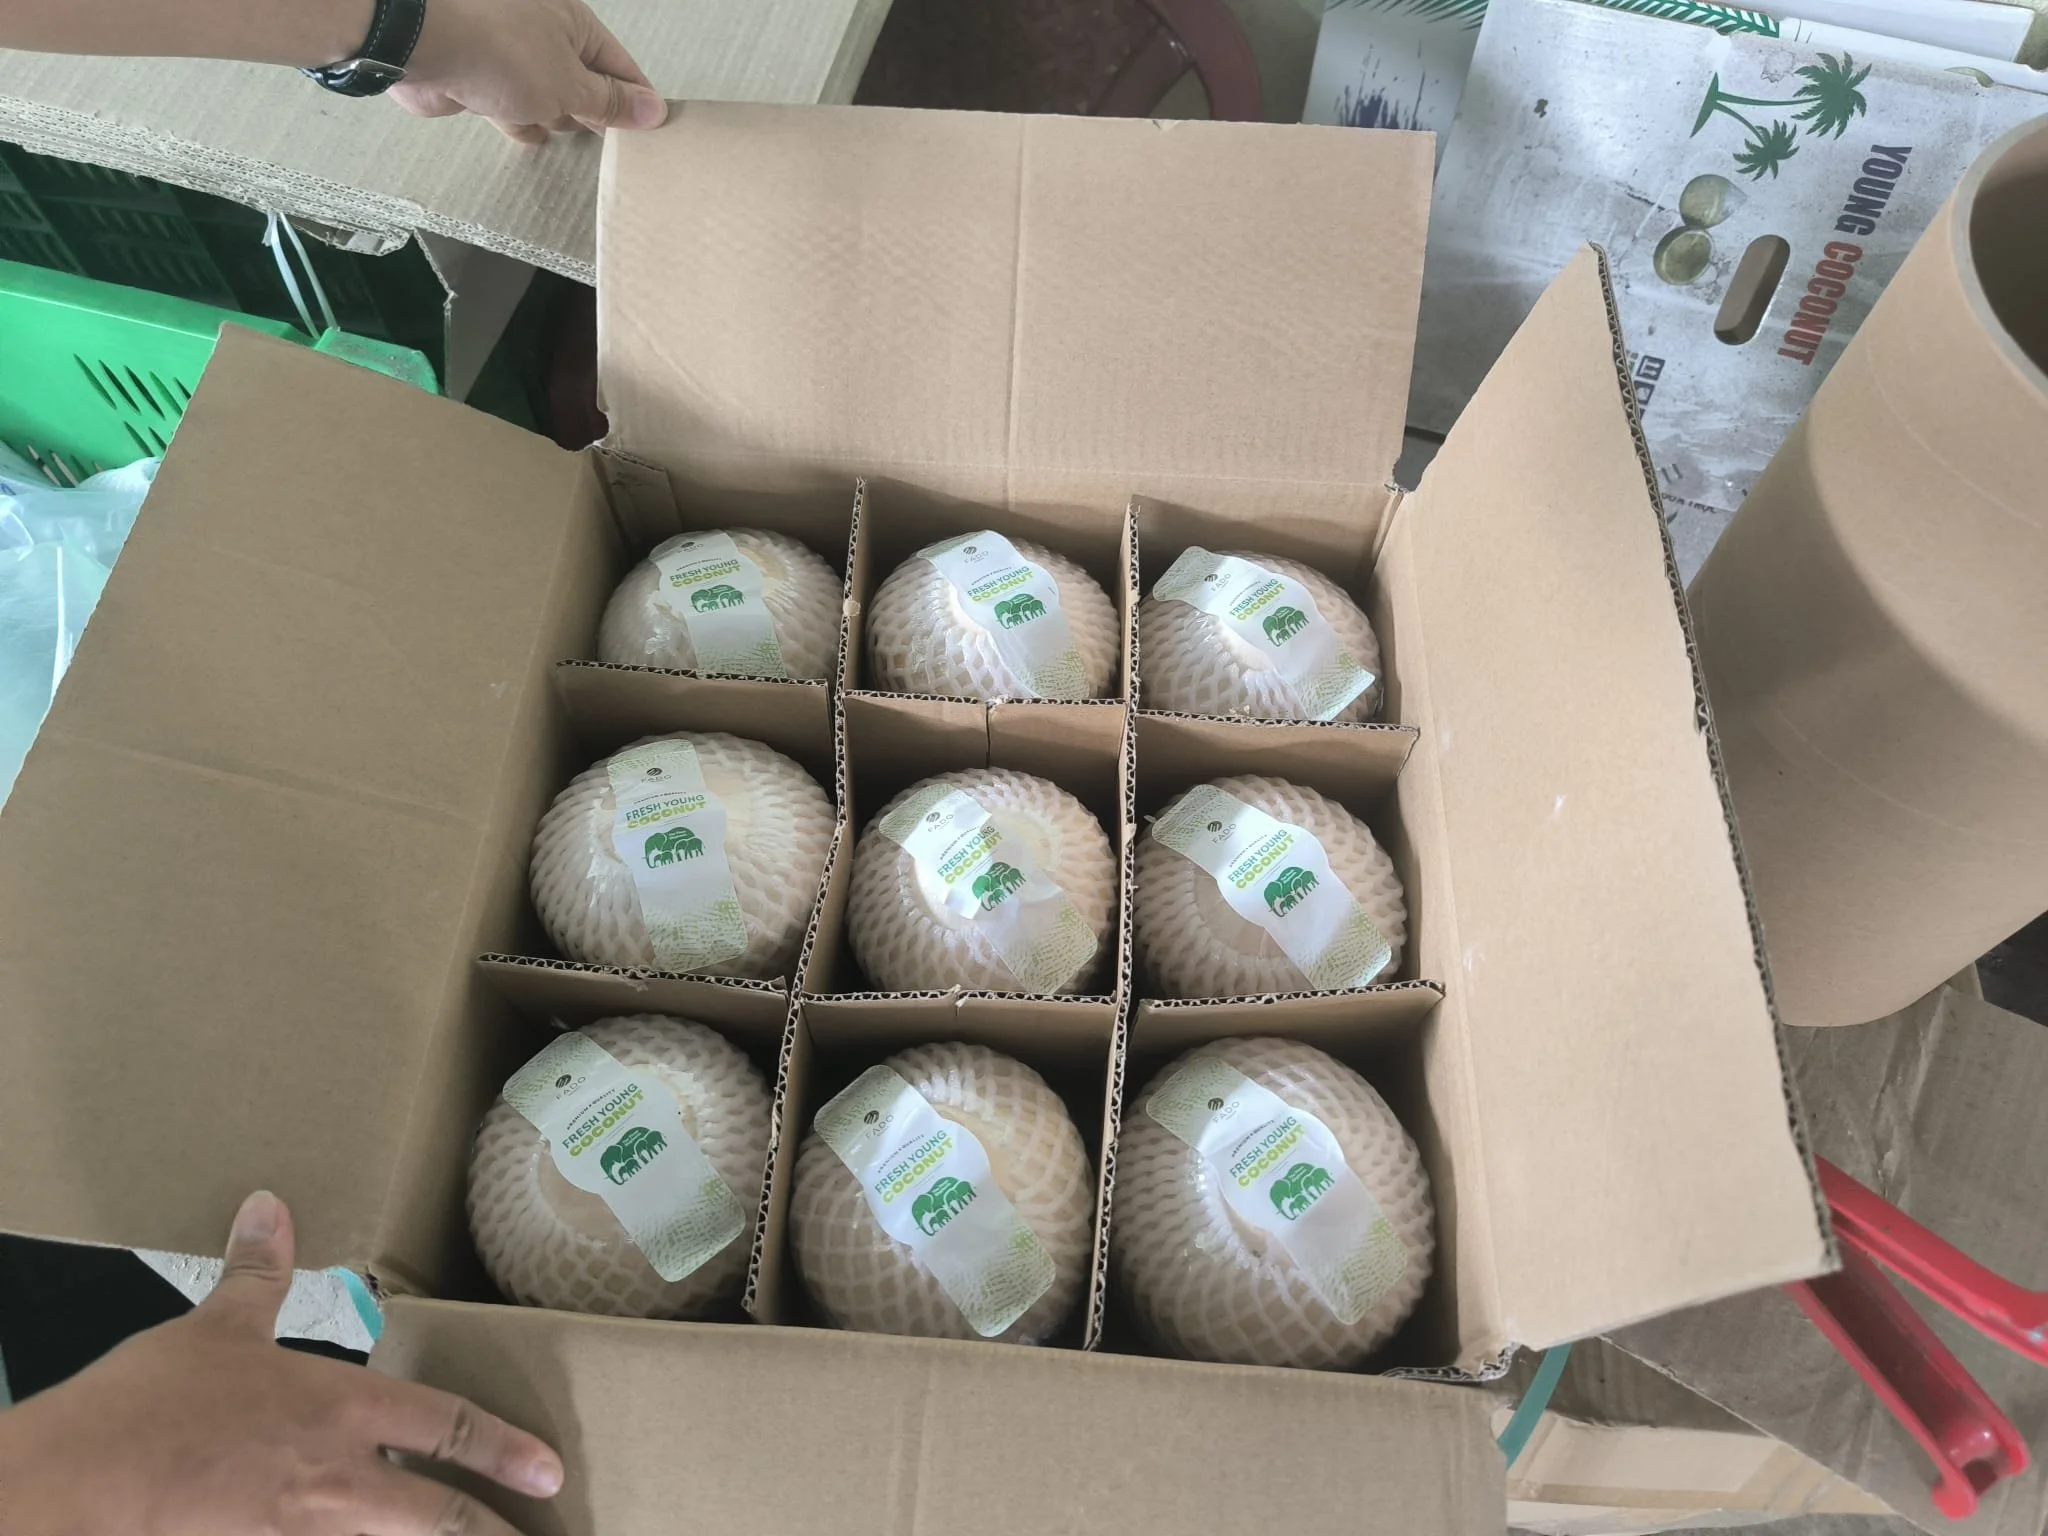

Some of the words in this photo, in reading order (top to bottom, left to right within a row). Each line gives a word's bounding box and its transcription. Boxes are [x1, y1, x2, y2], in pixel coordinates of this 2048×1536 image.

[1834, 144, 1913, 236] YOUNG
[1777, 240, 1863, 366] COCONUT
[670, 569, 701, 581] FRESH
[703, 559, 737, 572] YOUNG
[673, 566, 741, 587] COCONUT
[968, 580, 997, 596] FRESH
[998, 566, 1029, 582] YOUNG
[972, 572, 1033, 601] COCONUT
[1230, 595, 1255, 616] FRESH
[1254, 579, 1278, 598] YOUNG
[1237, 584, 1285, 620] COCONUT
[625, 802, 661, 821] FRESH
[663, 795, 704, 806] YOUNG
[627, 801, 706, 828] COCONUT
[937, 848, 969, 876] FRESH
[965, 826, 995, 849] YOUNG
[945, 831, 1002, 884] COCONUT
[1228, 855, 1258, 882] FRESH
[1254, 829, 1287, 856] YOUNG
[1236, 834, 1294, 888] COCONUT
[562, 1115, 600, 1149] FRESH
[597, 1083, 638, 1117] YOUNG
[569, 1089, 644, 1157] COCONUT
[1212, 1101, 1241, 1123] FADO
[875, 1161, 910, 1194] FRESH
[907, 1130, 947, 1164] YOUNG
[882, 1137, 953, 1204] COCONUT
[1229, 1146, 1263, 1178] FRESH
[1260, 1115, 1297, 1149] YOUNG
[1239, 1125, 1304, 1186] COCONUT
